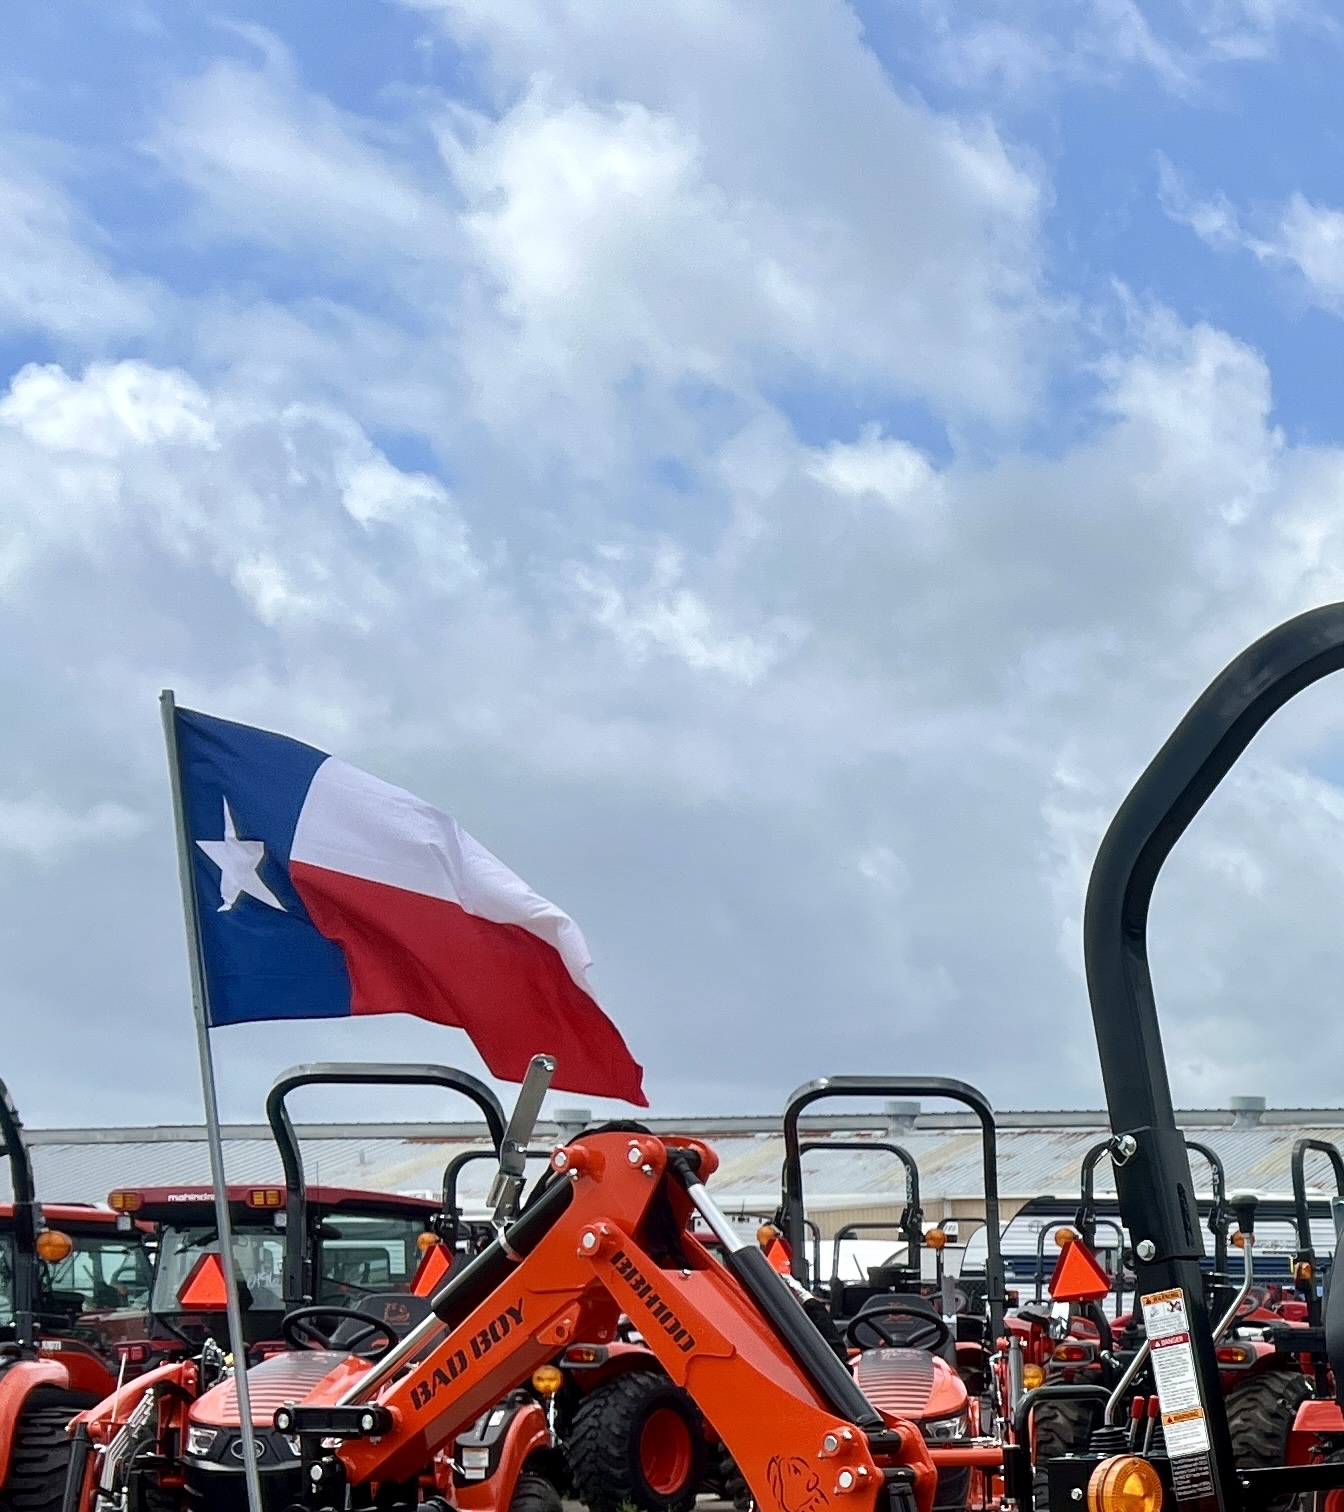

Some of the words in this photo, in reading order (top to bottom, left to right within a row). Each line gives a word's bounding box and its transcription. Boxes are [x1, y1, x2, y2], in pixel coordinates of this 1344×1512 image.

[167, 1193, 216, 1202] mahindr
[409, 1355, 469, 1412] BAD
[469, 1297, 525, 1361] BOY
